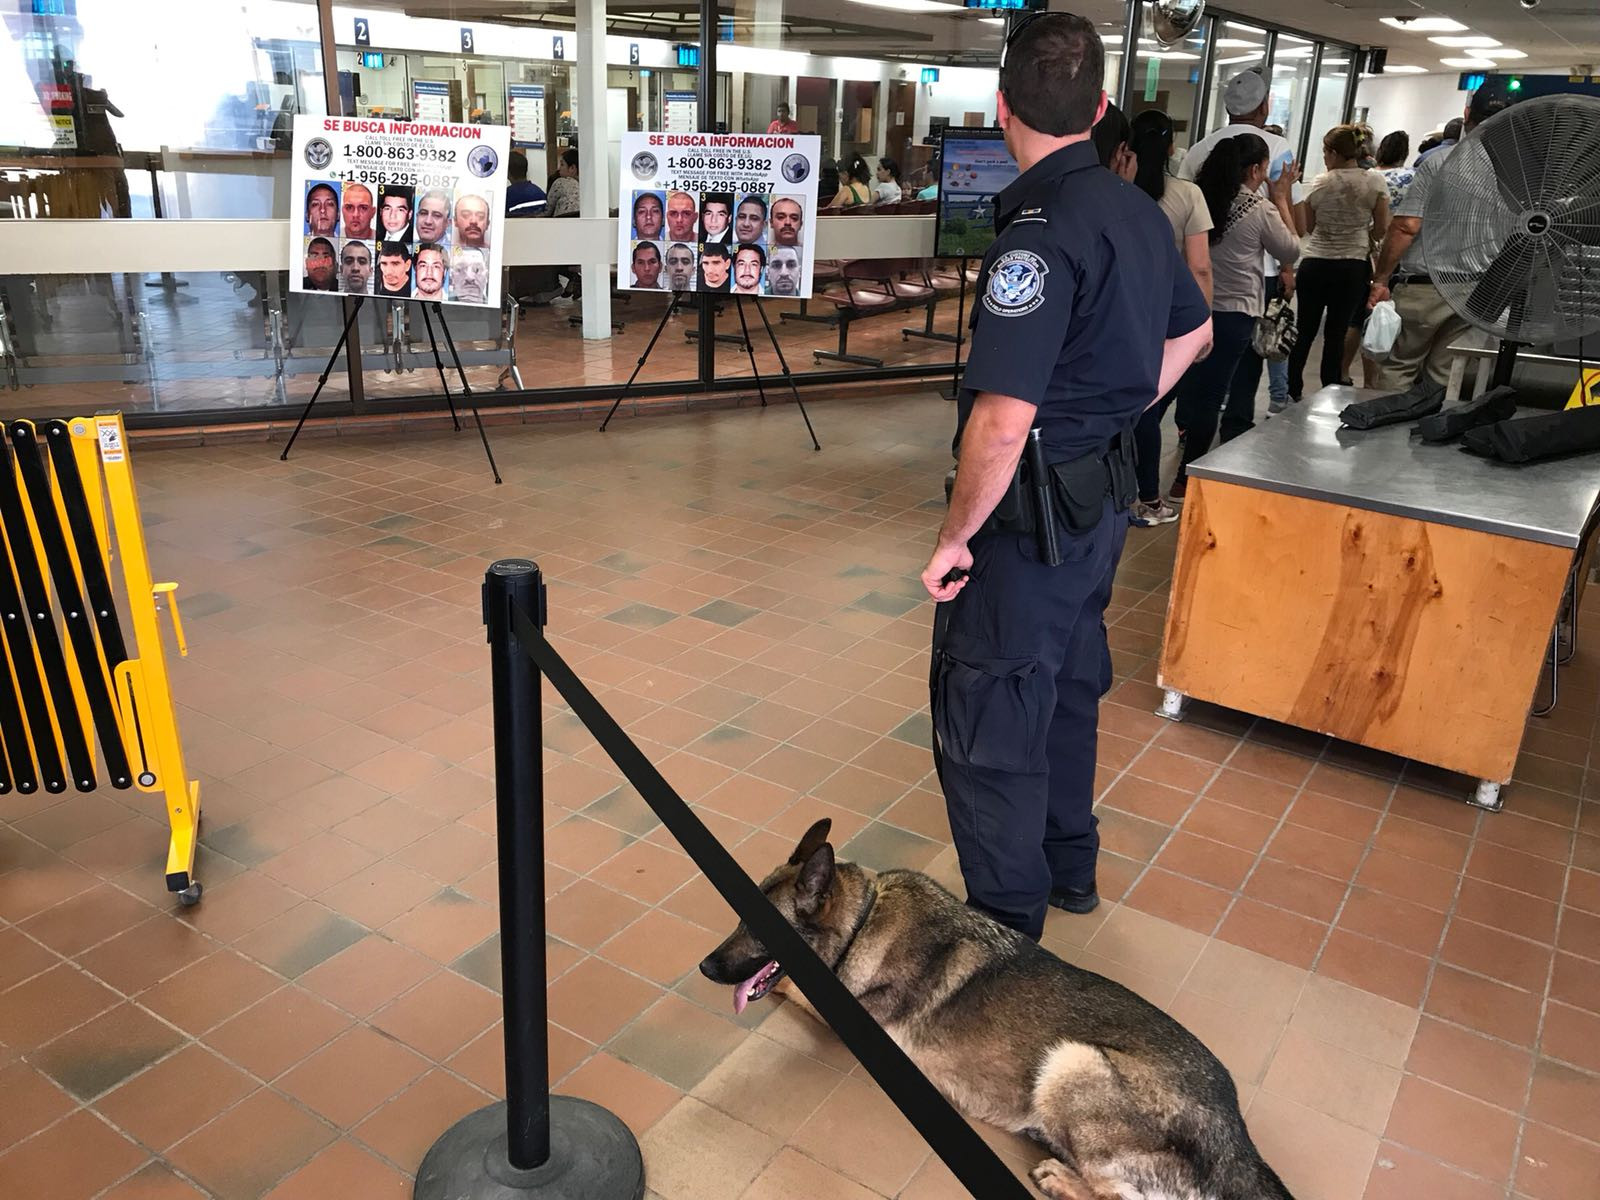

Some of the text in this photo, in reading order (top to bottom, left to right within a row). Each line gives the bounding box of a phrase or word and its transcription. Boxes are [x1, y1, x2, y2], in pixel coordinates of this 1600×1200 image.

[356, 22, 367, 40] 2
[464, 32, 472, 48] 3
[554, 39, 562, 56] 4
[632, 47, 638, 61] 5
[357, 52, 362, 65] 2
[324, 119, 481, 139] SE BUSCA INFORMACION
[649, 136, 794, 148] SE BUSCA INFORMACION
[343, 144, 456, 162] 1-800-863-9382
[934, 151, 940, 160] 7
[667, 157, 772, 170] 1-800-863-9382
[338, 170, 460, 188] +1-956-295-0887
[379, 185, 384, 195] 3
[663, 180, 775, 193] +1-956-295-0887
[701, 193, 706, 201] 3
[376, 242, 382, 251] 8
[699, 243, 704, 252] 8
